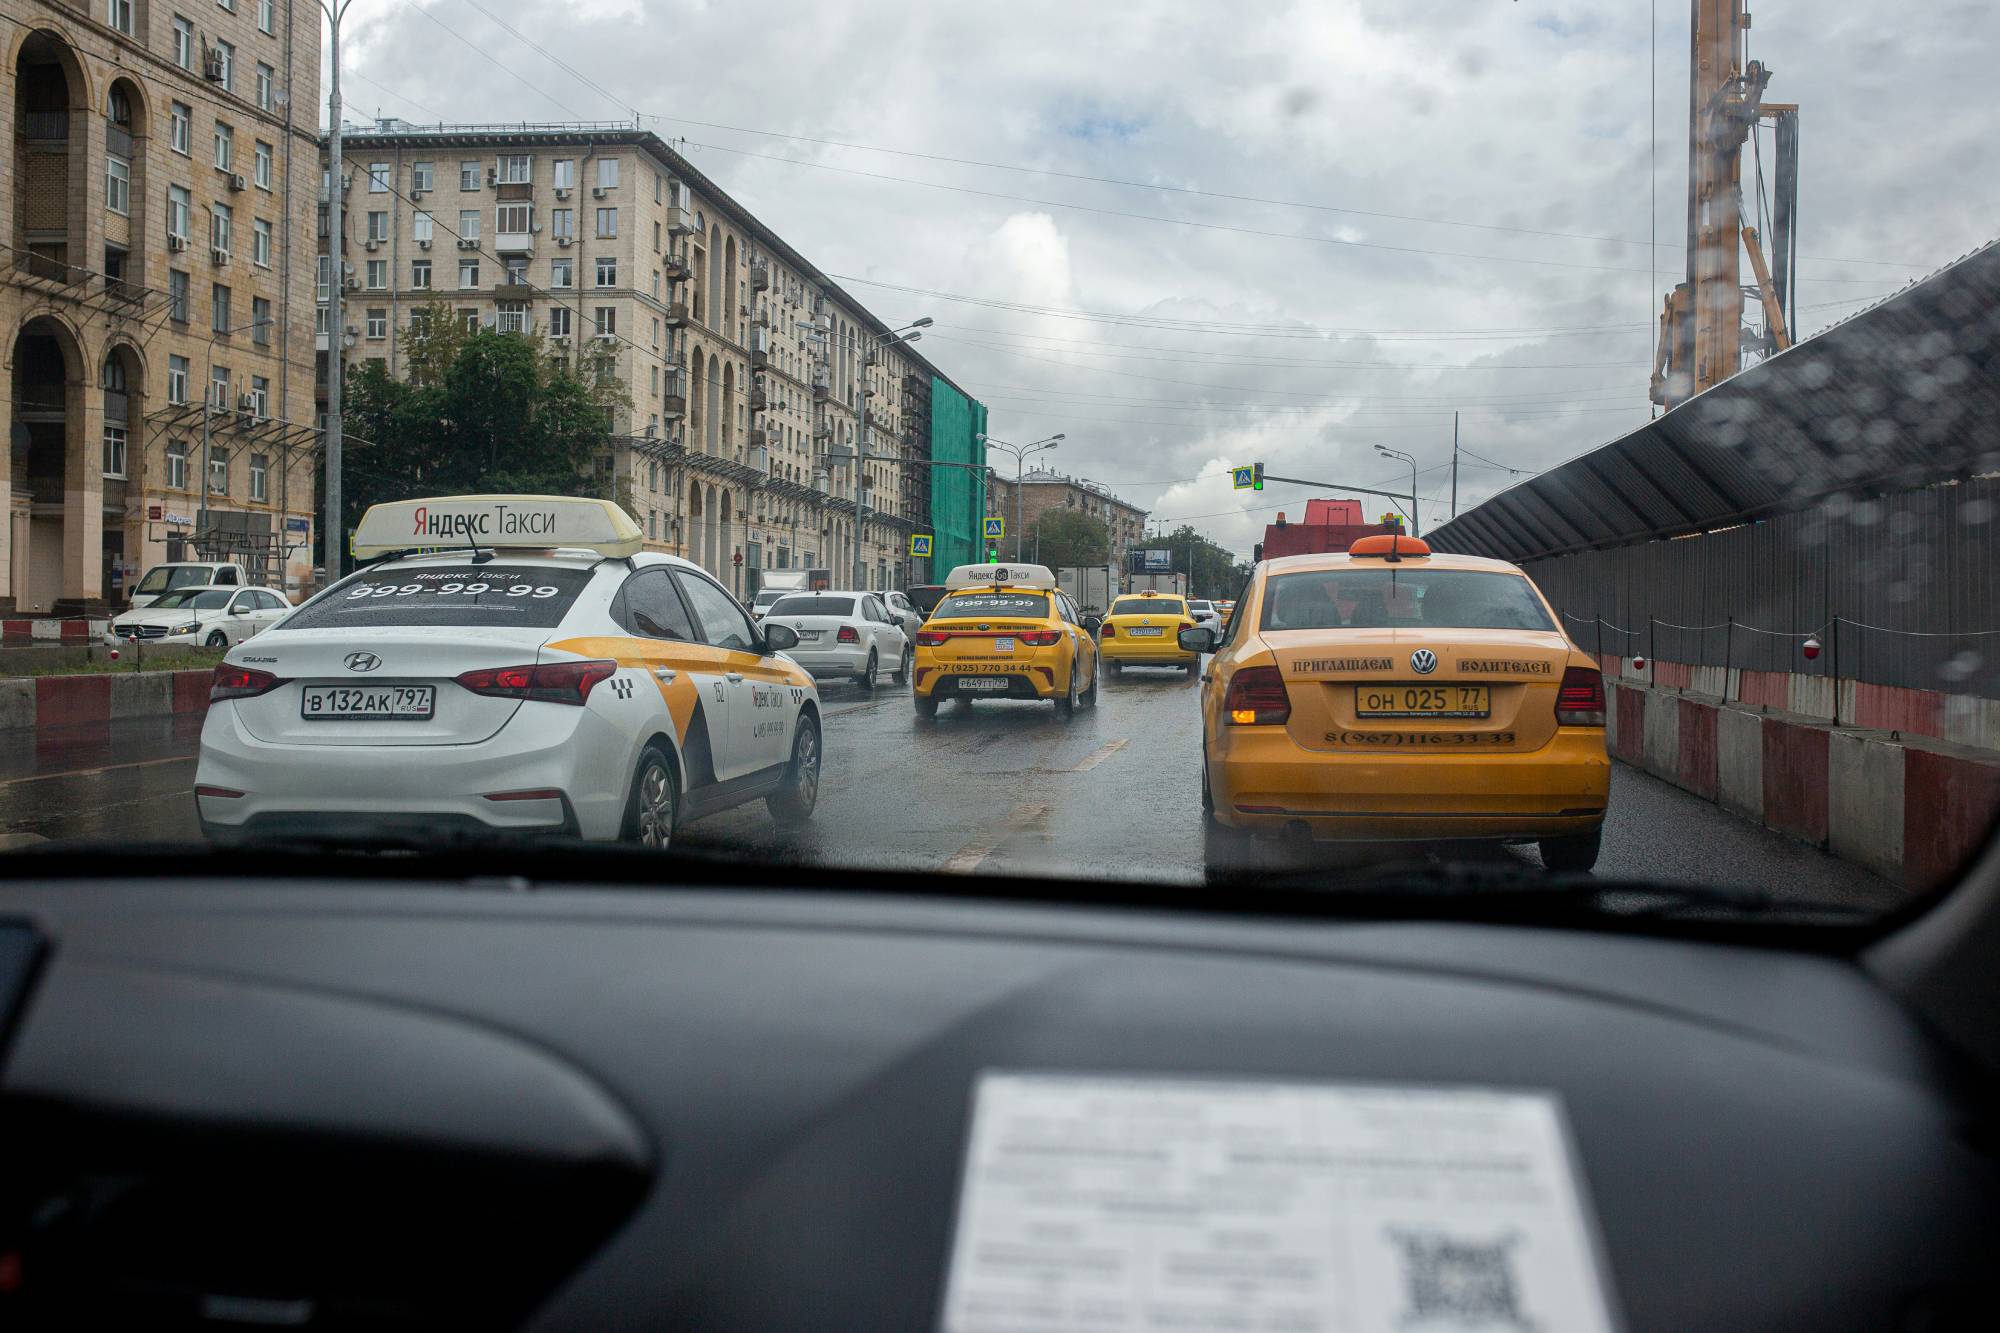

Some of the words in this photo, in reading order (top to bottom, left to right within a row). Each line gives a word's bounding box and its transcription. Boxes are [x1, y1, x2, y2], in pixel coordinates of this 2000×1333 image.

[414, 507, 490, 538] Яндекс
[495, 505, 555, 534] Такси
[968, 571, 994, 581] Яндекс
[1010, 569, 1030, 579] Такси
[346, 583, 559, 600] 999-99-99
[955, 600, 1034, 608] 999-99-99
[952, 664, 979, 673] (925)
[394, 688, 427, 706] 797
[1367, 695, 1395, 710] ОН
[1405, 689, 1447, 710] 025
[1459, 688, 1481, 704] 77
